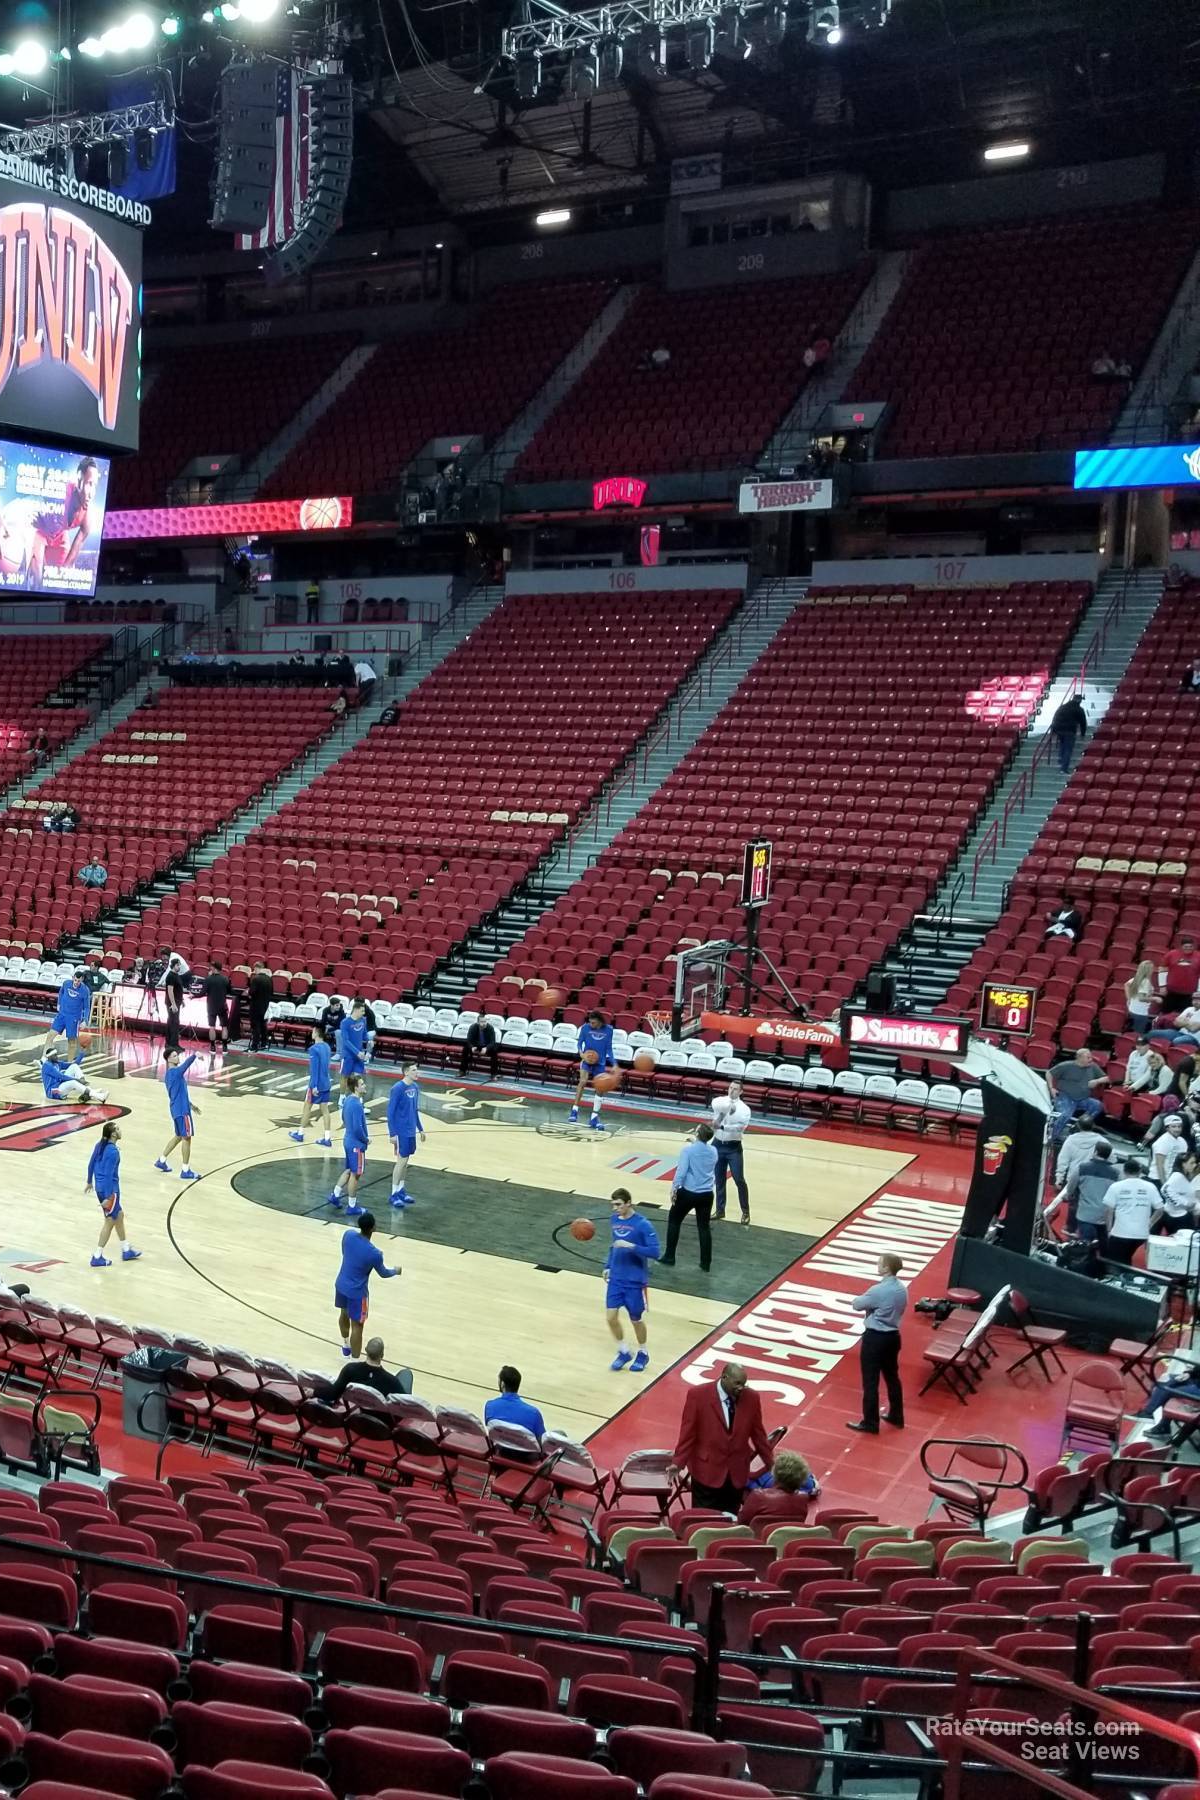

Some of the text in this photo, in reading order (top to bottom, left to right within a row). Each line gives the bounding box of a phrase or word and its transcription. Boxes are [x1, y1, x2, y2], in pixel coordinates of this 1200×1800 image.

[59, 172, 153, 226] SCOREBOARD
[738, 253, 764, 271] 209
[593, 476, 648, 511] UNLV
[758, 494, 815, 510] HERBST
[6, 573, 25, 584] 2019
[934, 562, 967, 580] 107
[609, 572, 635, 589] 106
[338, 583, 361, 597] 105
[990, 991, 1029, 1008] 46:55
[1008, 1008, 1020, 1026] 0
